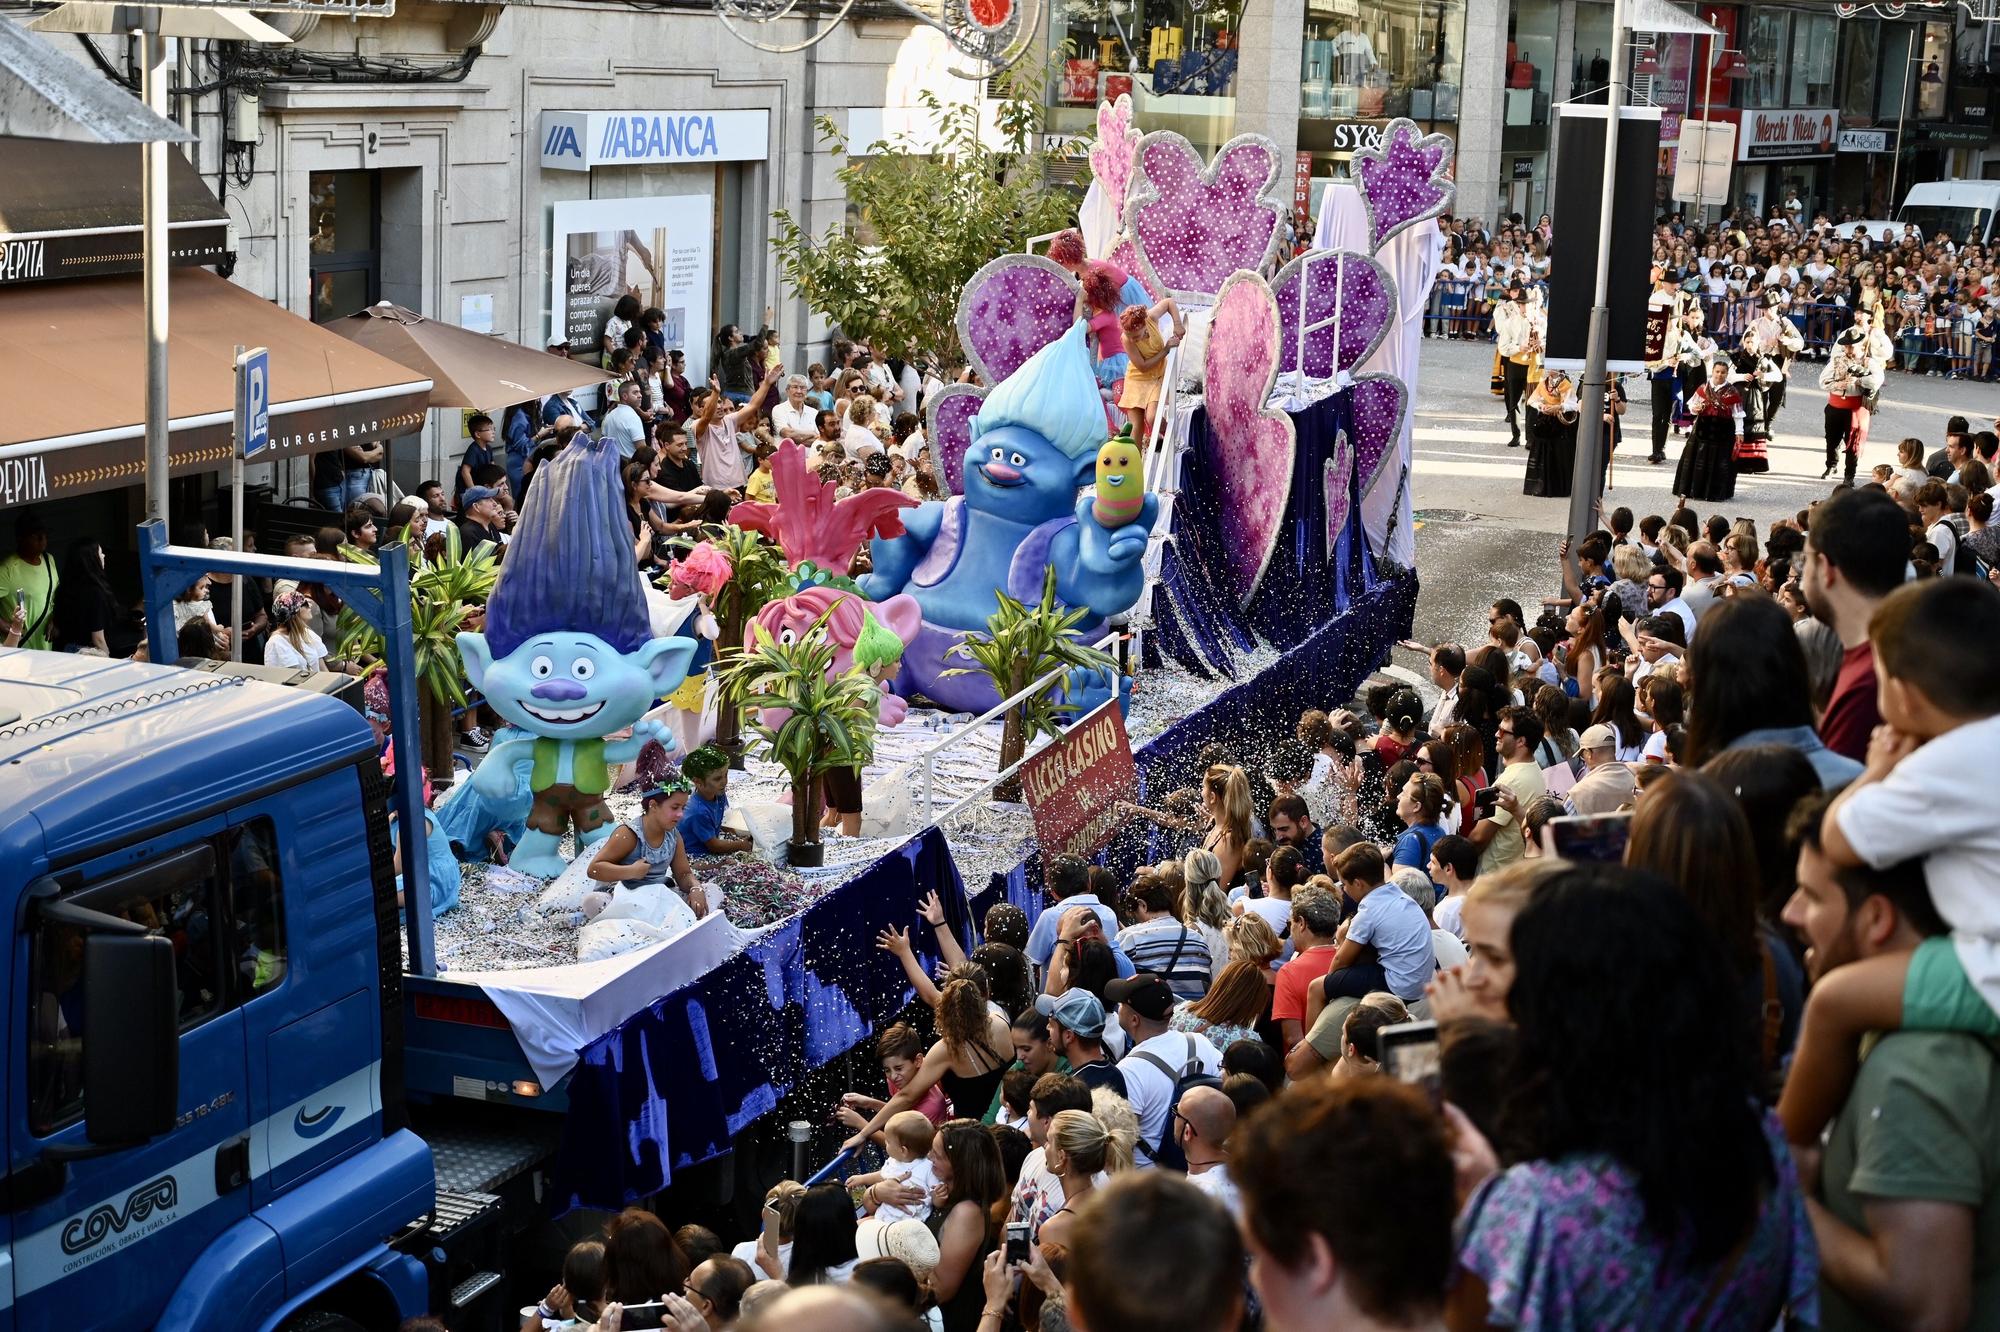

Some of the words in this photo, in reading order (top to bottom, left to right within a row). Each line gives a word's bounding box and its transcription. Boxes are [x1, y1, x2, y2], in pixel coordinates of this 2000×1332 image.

[1755, 113, 1790, 142] Merchi
[1792, 113, 1817, 141] Nieto
[368, 131, 377, 154] 2
[1857, 139, 1882, 149] NOITE
[171, 249, 199, 257] RGER
[205, 246, 223, 255] BAR
[570, 268, 580, 279] Un
[570, 283, 591, 293] queres
[570, 297, 592, 307] aprazar
[575, 323, 592, 332] outro
[249, 366, 264, 443] P
[269, 428, 340, 450] BURGER
[349, 421, 378, 436] BAR
[1028, 751, 1066, 807] LICEO
[1067, 715, 1117, 778] CASINO
[118, 1231, 141, 1247] OBRAS
[141, 1228, 145, 1236] E
